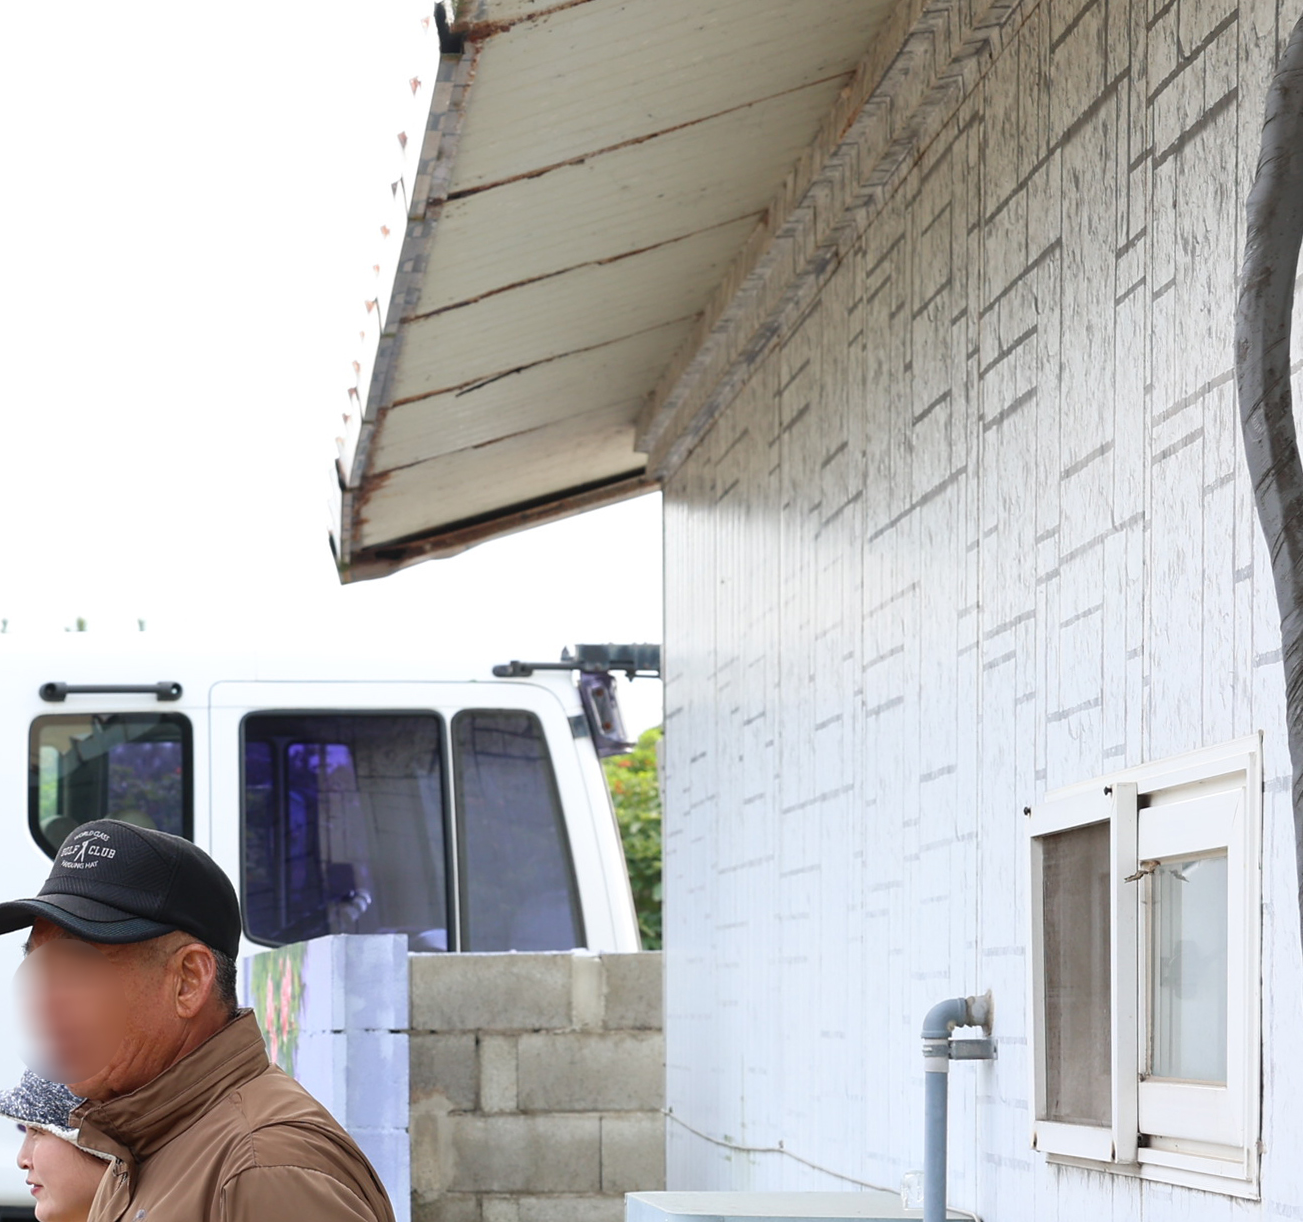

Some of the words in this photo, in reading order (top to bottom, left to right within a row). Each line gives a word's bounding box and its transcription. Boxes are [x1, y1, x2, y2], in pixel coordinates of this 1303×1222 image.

[74, 830, 94, 840] WORLD
[94, 831, 110, 842] CLASS
[61, 845, 81, 857] GOLF
[88, 845, 116, 859] CLUB
[85, 860, 98, 868] HAT
